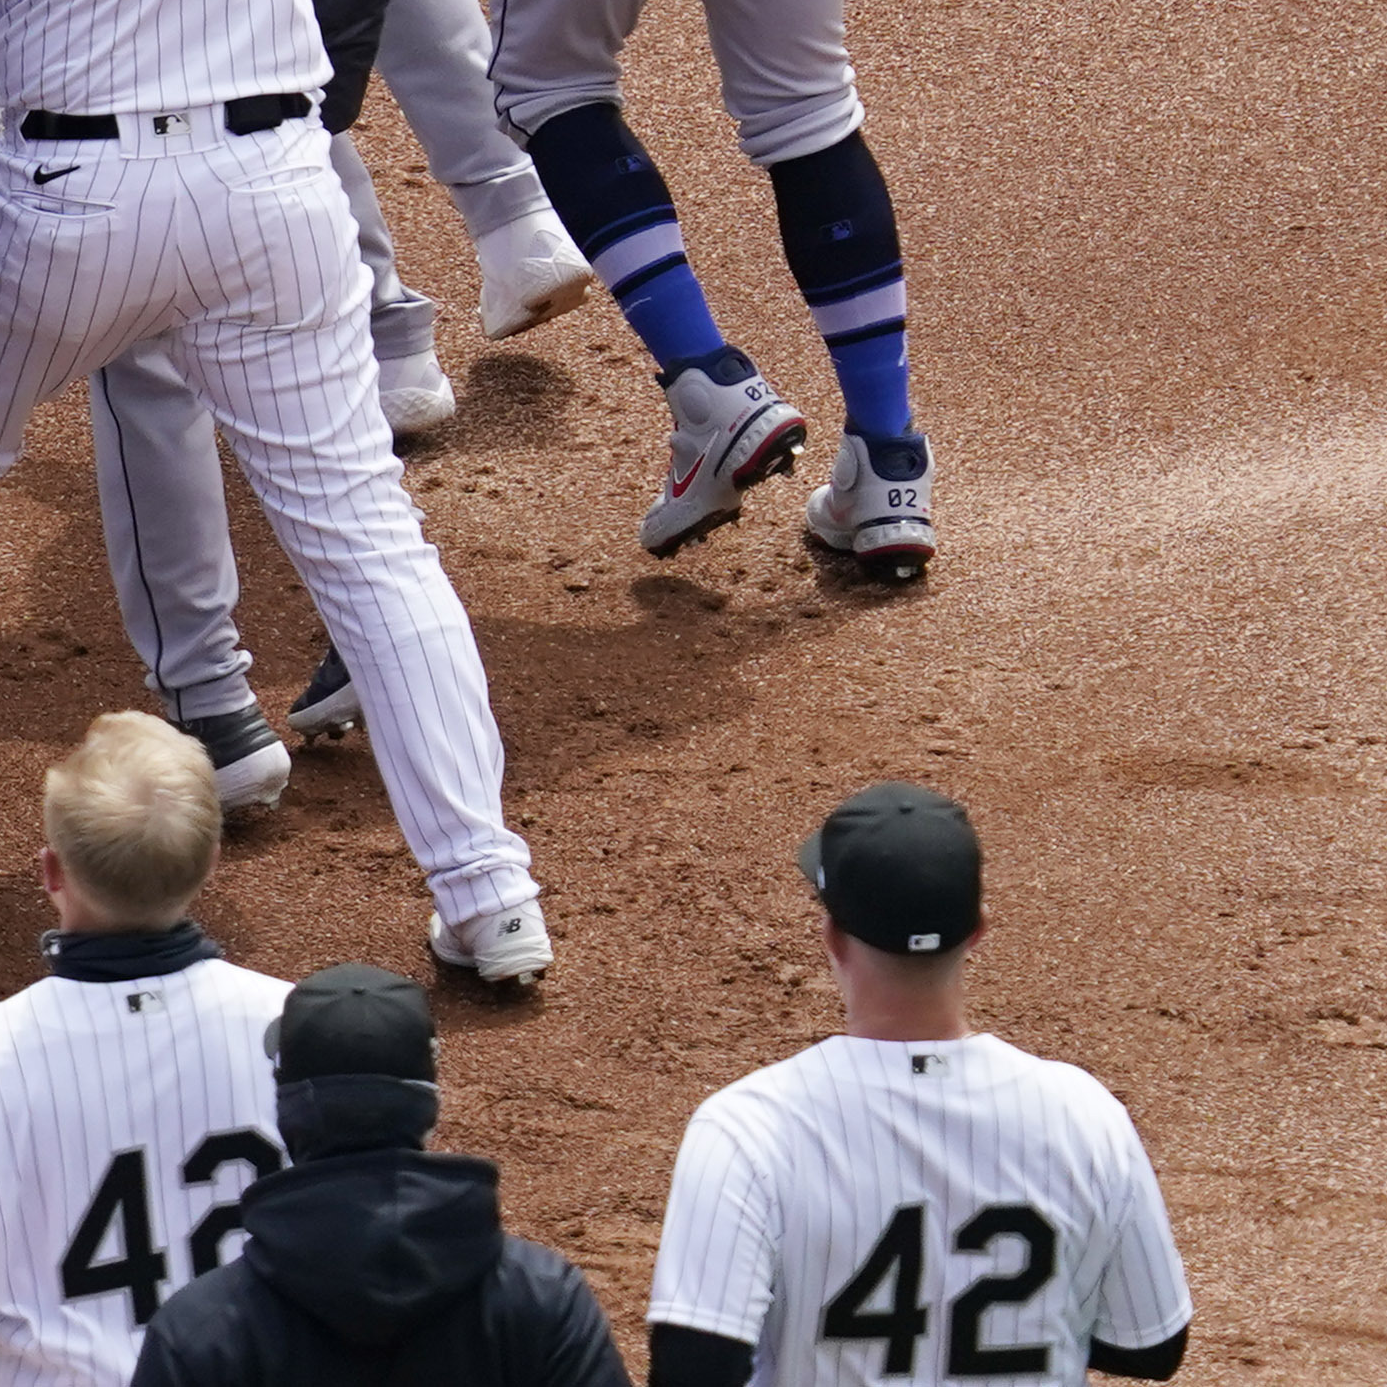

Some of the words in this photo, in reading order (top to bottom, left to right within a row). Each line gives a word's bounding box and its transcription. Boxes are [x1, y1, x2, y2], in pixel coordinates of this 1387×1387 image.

[745, 382, 774, 401] 02
[888, 488, 917, 508] 02
[60, 1125, 292, 1328] 42
[824, 1200, 1057, 1380] 42
